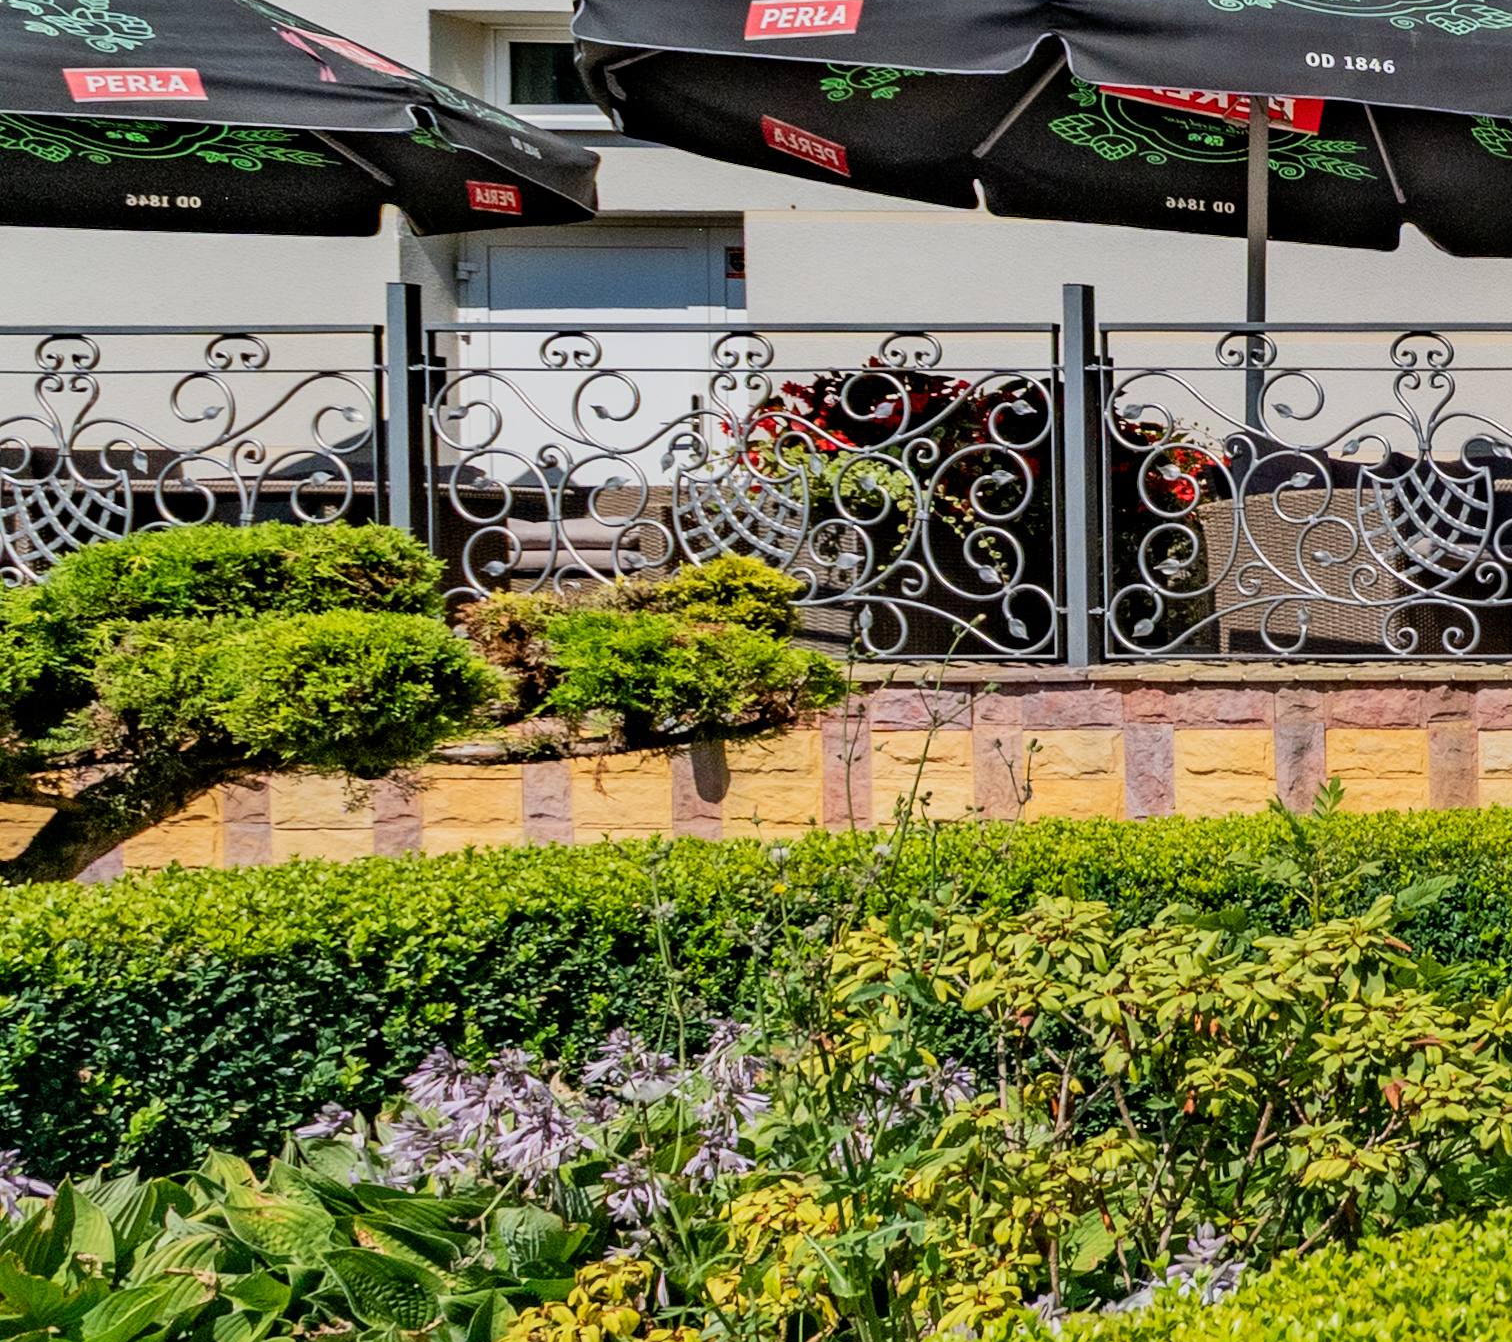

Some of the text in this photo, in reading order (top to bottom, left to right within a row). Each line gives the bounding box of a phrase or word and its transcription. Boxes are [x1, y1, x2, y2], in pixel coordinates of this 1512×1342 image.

[759, 4, 847, 30] PERŁA
[1305, 52, 1396, 75] OD 1846
[84, 74, 190, 93] PERŁA
